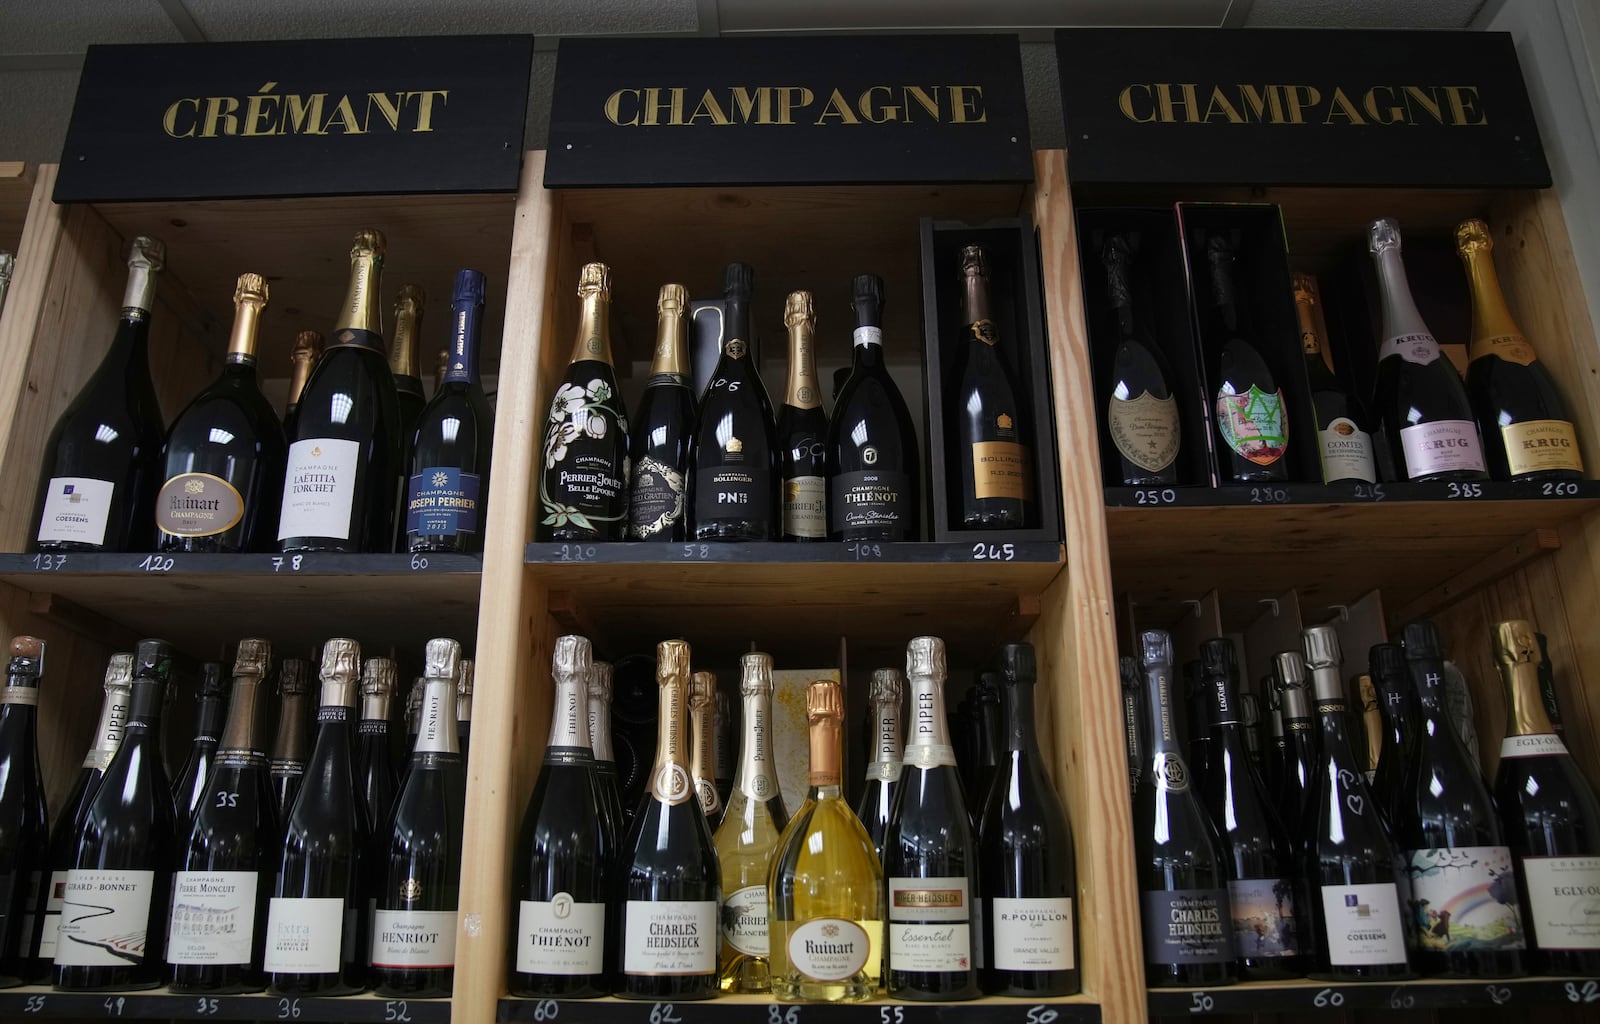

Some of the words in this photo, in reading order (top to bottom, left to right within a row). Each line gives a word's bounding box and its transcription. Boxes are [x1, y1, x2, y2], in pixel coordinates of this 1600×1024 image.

[163, 81, 449, 138] CRÉMANT
[604, 85, 987, 127] CHAMPAGNE
[1119, 83, 1488, 127] CHAMPAGNE
[351, 263, 366, 314] CHAMPAGNE
[1396, 334, 1434, 345] KRUG
[1420, 438, 1469, 449] KRUG
[1522, 438, 1571, 449] KRUG
[575, 456, 612, 467] CHAMPAGNE
[293, 472, 336, 484] LAËTITIA
[292, 484, 337, 494] TORCHET
[567, 484, 591, 492] BELLE
[644, 492, 674, 500] GRATIEN
[1447, 482, 1482, 498] 385
[1542, 482, 1578, 496] 260
[169, 496, 220, 511] Ruinart
[409, 497, 435, 510] JOSEPH
[438, 497, 475, 509] PERRIER
[718, 492, 738, 504] PN
[844, 491, 898, 503] THIÉNOT
[1134, 489, 1175, 504] 250
[55, 515, 88, 523] COESSENS
[170, 511, 215, 520] CHAMPAGNE
[683, 544, 710, 558] 58
[972, 543, 1015, 561] 245
[32, 553, 67, 571] 137
[138, 554, 175, 571] 120
[410, 554, 429, 570] 60
[1158, 675, 1168, 705] CHARLES
[1216, 680, 1228, 712] LEMAIRE
[670, 689, 678, 719] CHARLES
[427, 696, 439, 740] HENRIOT
[919, 693, 933, 734] PIPER
[107, 704, 127, 742] PIPER
[1160, 706, 1171, 741] HEIDSIECK
[669, 720, 677, 755] HEIDSIECK
[883, 717, 895, 753] PIPER
[215, 792, 240, 808] 35
[99, 883, 137, 892] BONNET
[179, 882, 198, 892] PIERRE
[200, 883, 236, 893] MONCUIT
[1170, 899, 1217, 908] CHAMPAGNE
[1171, 908, 1219, 923] CHARLES
[277, 922, 310, 934] Extra
[649, 922, 697, 936] CHARLES
[901, 928, 954, 942] Essentiel
[1168, 922, 1223, 936] HEIDSIECK
[382, 931, 439, 944] HENRIOT
[530, 934, 592, 947] THIÉNOT
[647, 936, 700, 948] HEIDSIECK
[1347, 933, 1387, 941] COESSENS
[805, 940, 854, 954] Ruinart
[24, 995, 47, 1012] 55
[1189, 992, 1214, 1012] 50
[1314, 988, 1344, 1007] 60
[104, 997, 125, 1016] 49
[197, 998, 219, 1015] 35
[278, 998, 301, 1019] 36
[385, 1001, 412, 1022] 52
[534, 1000, 559, 1022] 60
[650, 1003, 682, 1024] 62
[768, 1004, 800, 1024] 86
[1026, 1005, 1059, 1024] 50
[880, 1006, 904, 1024] 55
